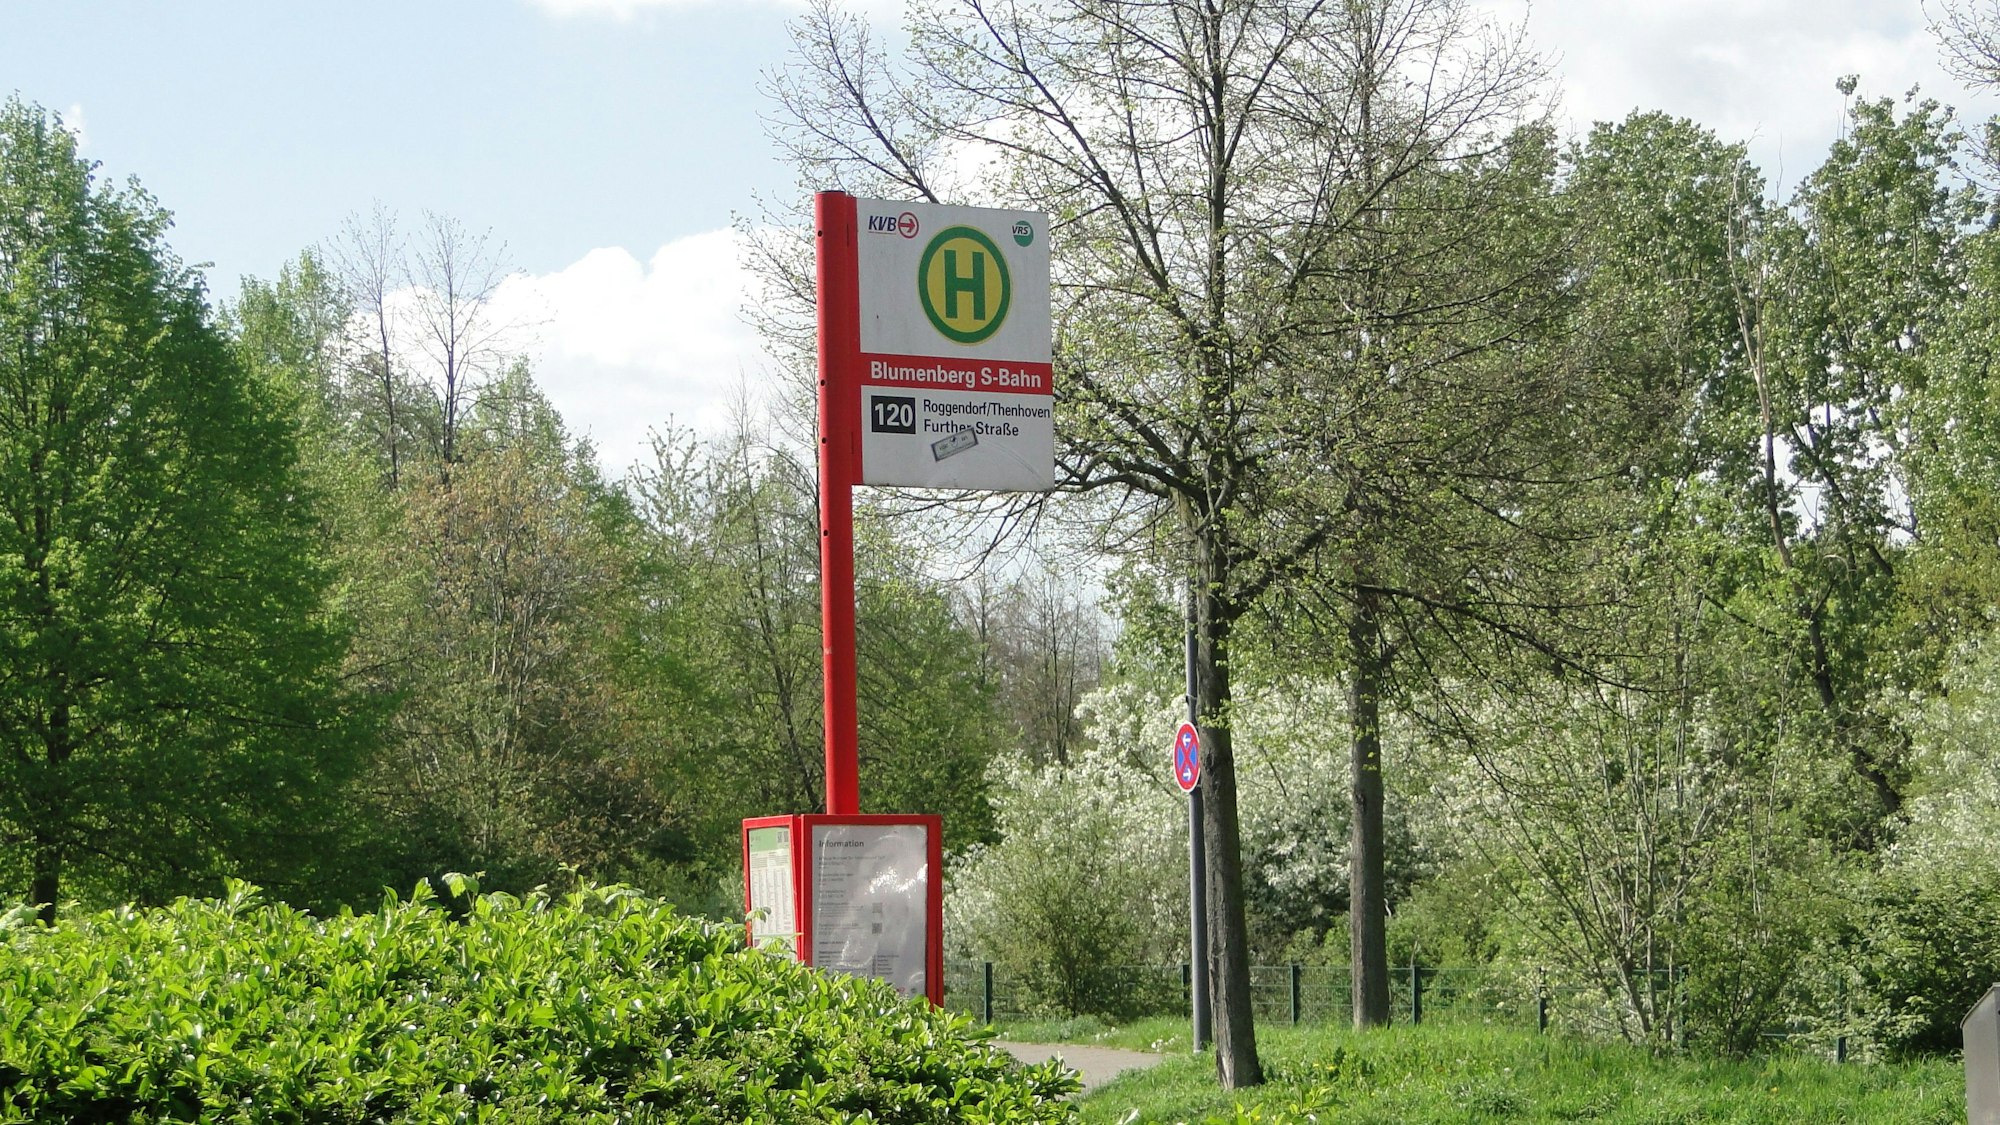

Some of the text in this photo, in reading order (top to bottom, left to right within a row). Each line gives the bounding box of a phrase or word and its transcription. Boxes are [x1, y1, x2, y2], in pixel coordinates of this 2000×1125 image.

[868, 215, 897, 232] KVB
[1011, 225, 1029, 236] VRS
[943, 249, 986, 321] H
[870, 361, 1042, 389] Blumenberg S-Bahn
[874, 403, 914, 428] 120
[923, 398, 1051, 419] Roggendorf/Thenhoven
[975, 421, 1020, 437] Straße
[818, 839, 865, 848] Information
